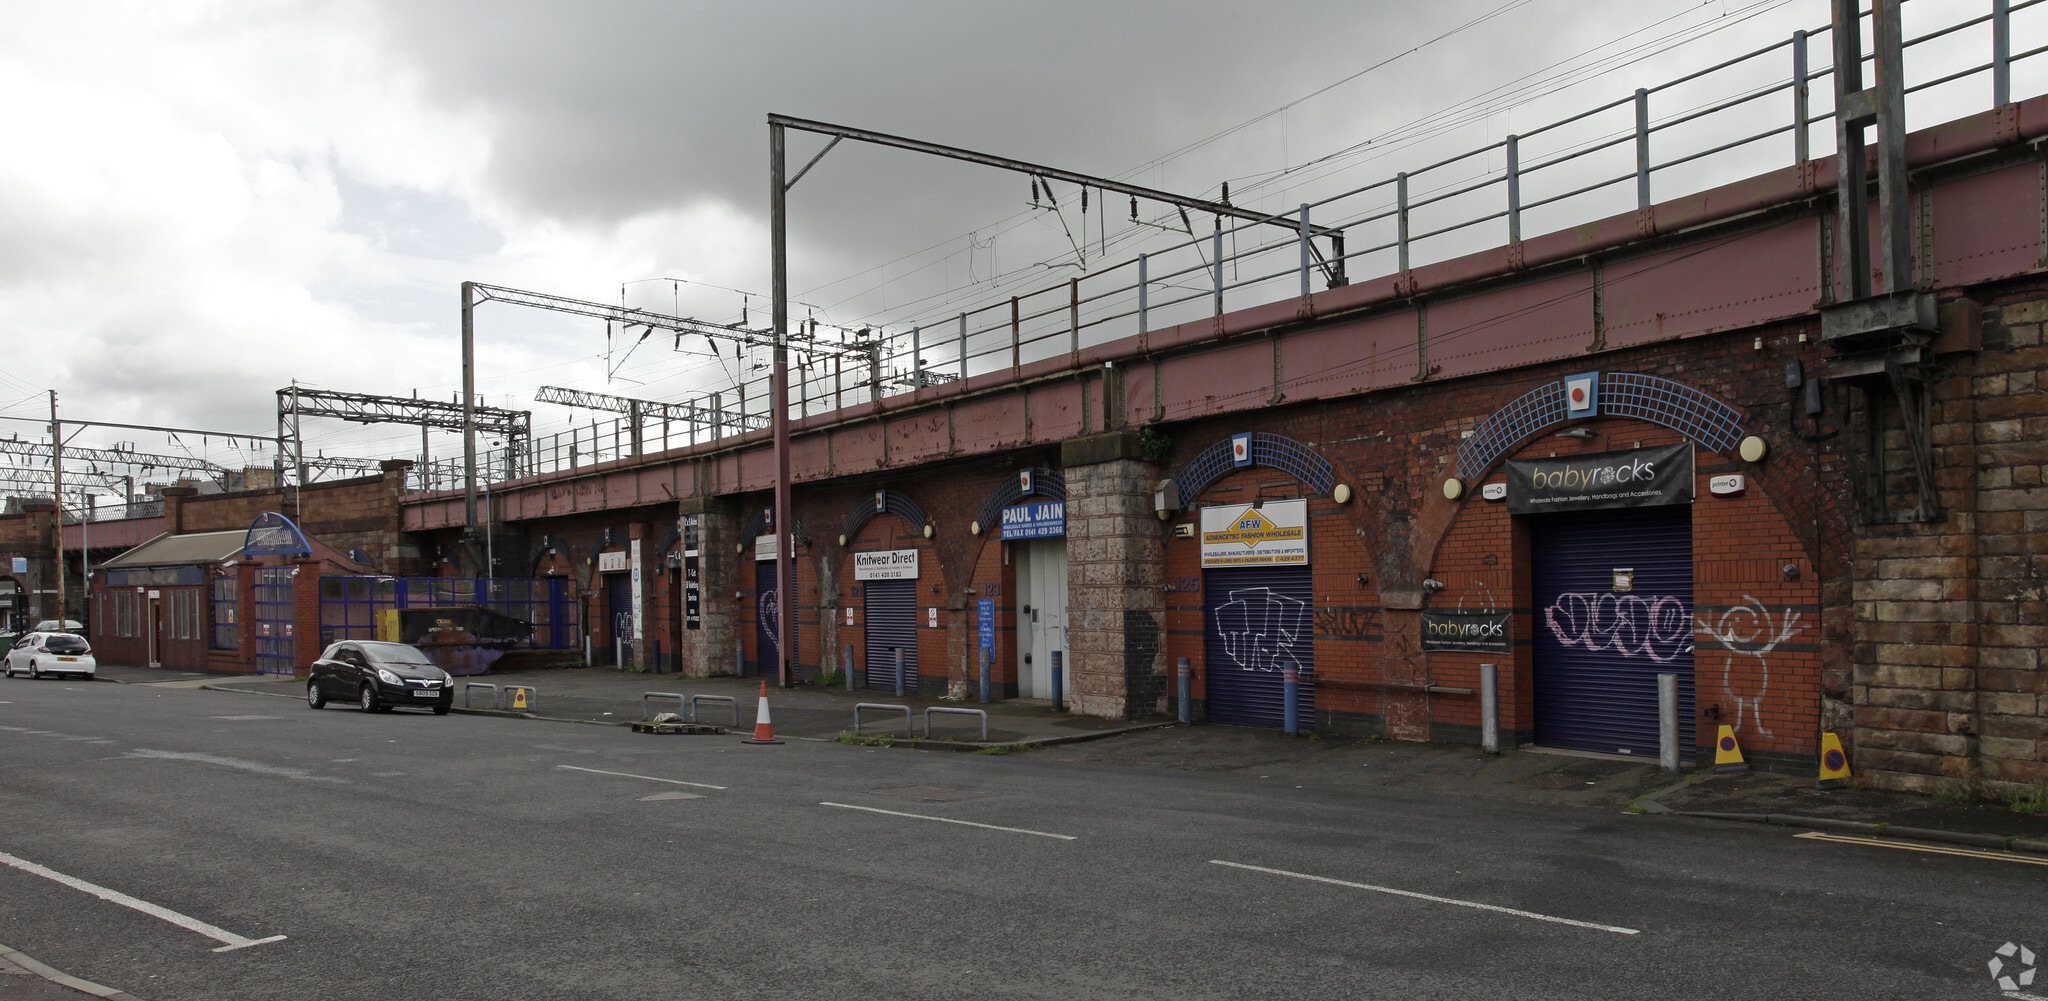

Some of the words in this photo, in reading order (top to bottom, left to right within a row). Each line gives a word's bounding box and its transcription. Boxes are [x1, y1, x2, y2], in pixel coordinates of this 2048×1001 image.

[1592, 492, 1618, 500] Handbags
[1002, 506, 1032, 524] PAUL
[1035, 503, 1063, 521] JAIN
[1239, 519, 1261, 530] AFW
[857, 553, 890, 565] Knitwear
[892, 552, 915, 564] Direct
[983, 583, 1000, 596] 123
[1175, 576, 1200, 592] 125
[1428, 619, 1503, 638] babyrocks
